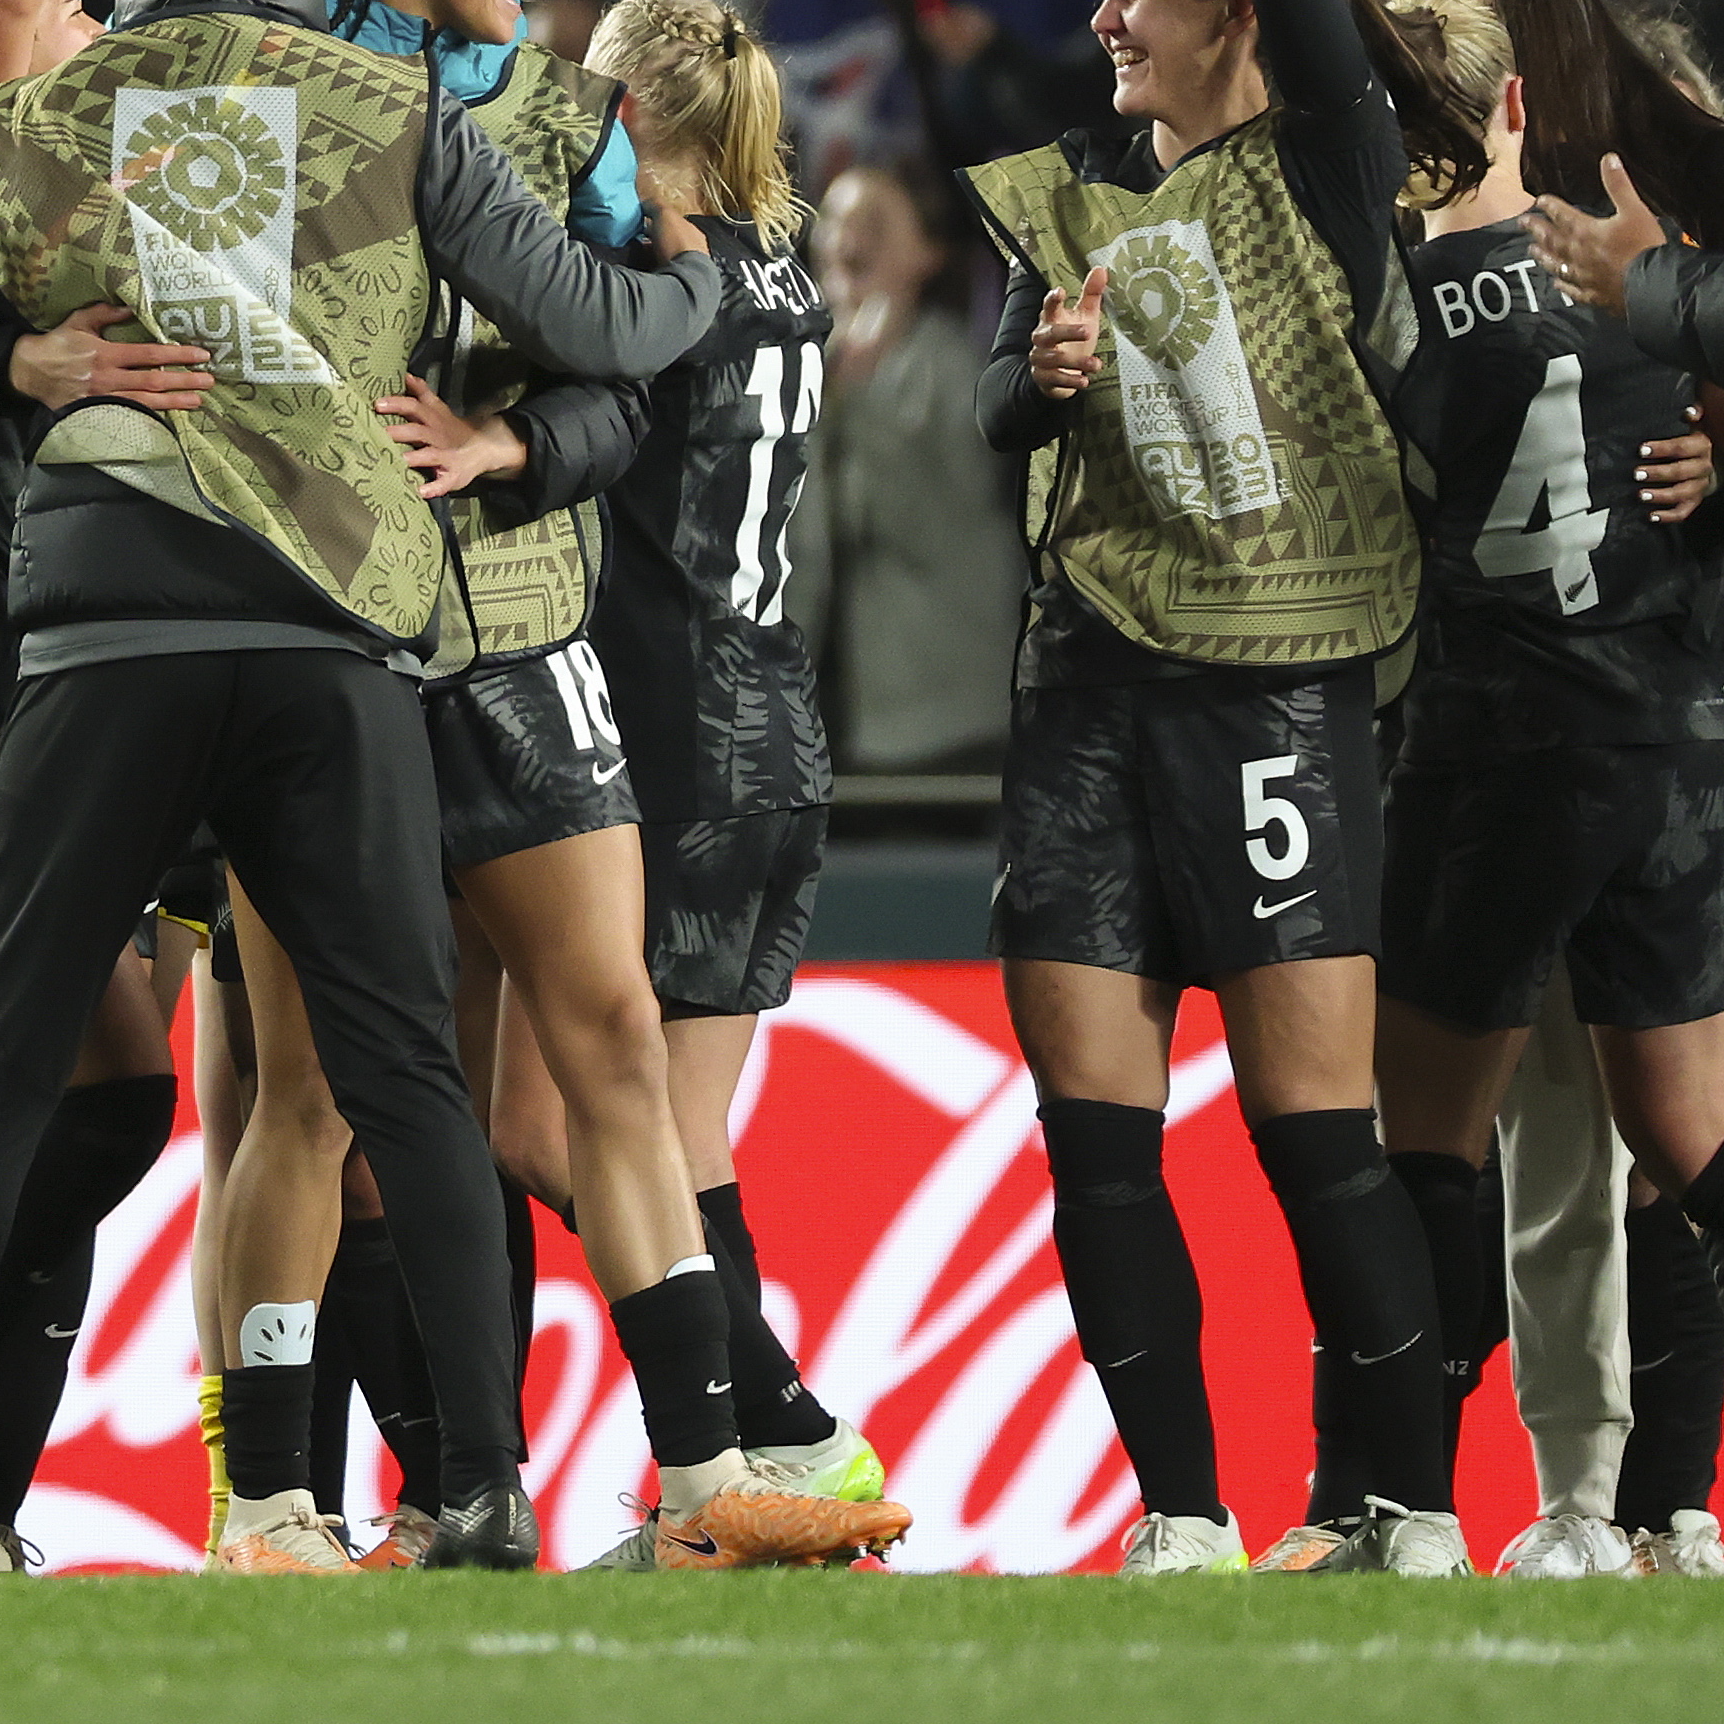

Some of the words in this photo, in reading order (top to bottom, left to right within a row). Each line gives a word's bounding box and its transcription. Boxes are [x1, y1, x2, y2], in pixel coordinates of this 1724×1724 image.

[1472, 353, 1610, 617] 4
[545, 639, 622, 751] 18
[1241, 754, 1310, 880] 5
